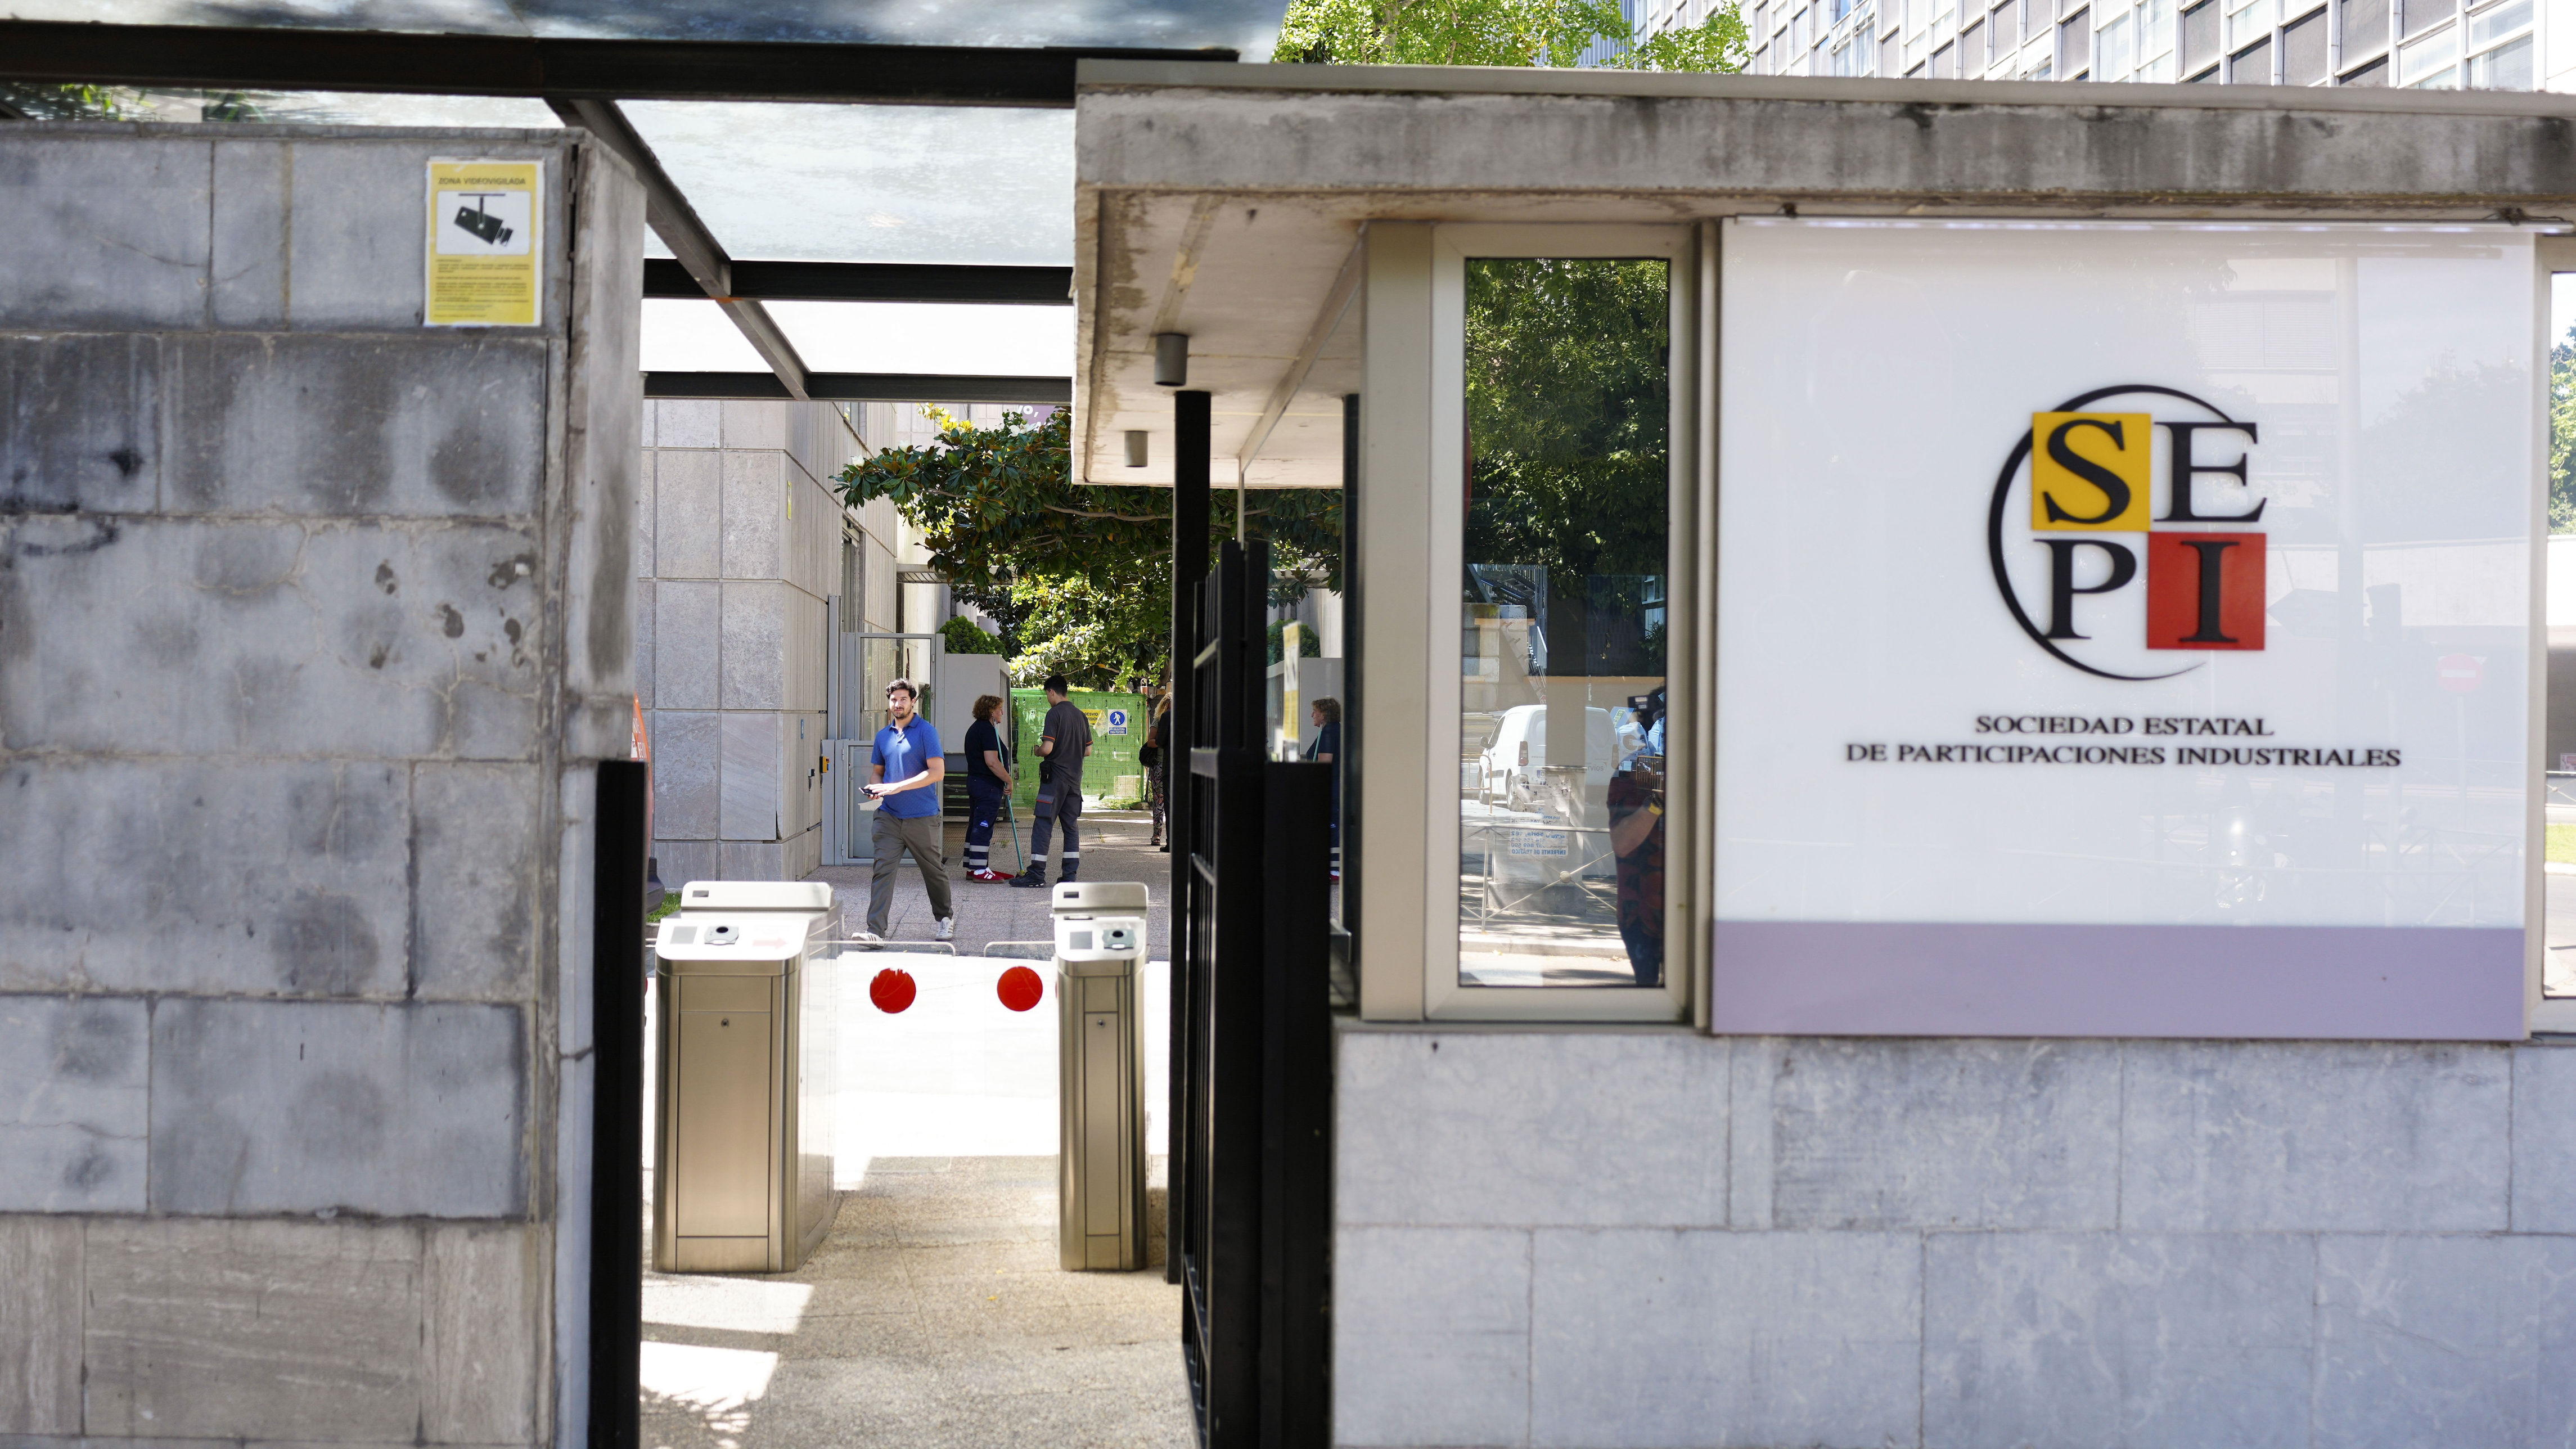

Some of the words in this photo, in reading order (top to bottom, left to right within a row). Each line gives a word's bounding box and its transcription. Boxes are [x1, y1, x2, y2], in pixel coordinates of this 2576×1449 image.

[1975, 716, 2134, 736] SOCIEDAD
[2143, 717, 2274, 736] ESTATAL
[1846, 744, 1887, 763] DE
[1897, 744, 2166, 765] PARTICIPACIONES
[2175, 747, 2401, 767] INDUSTRIALES
